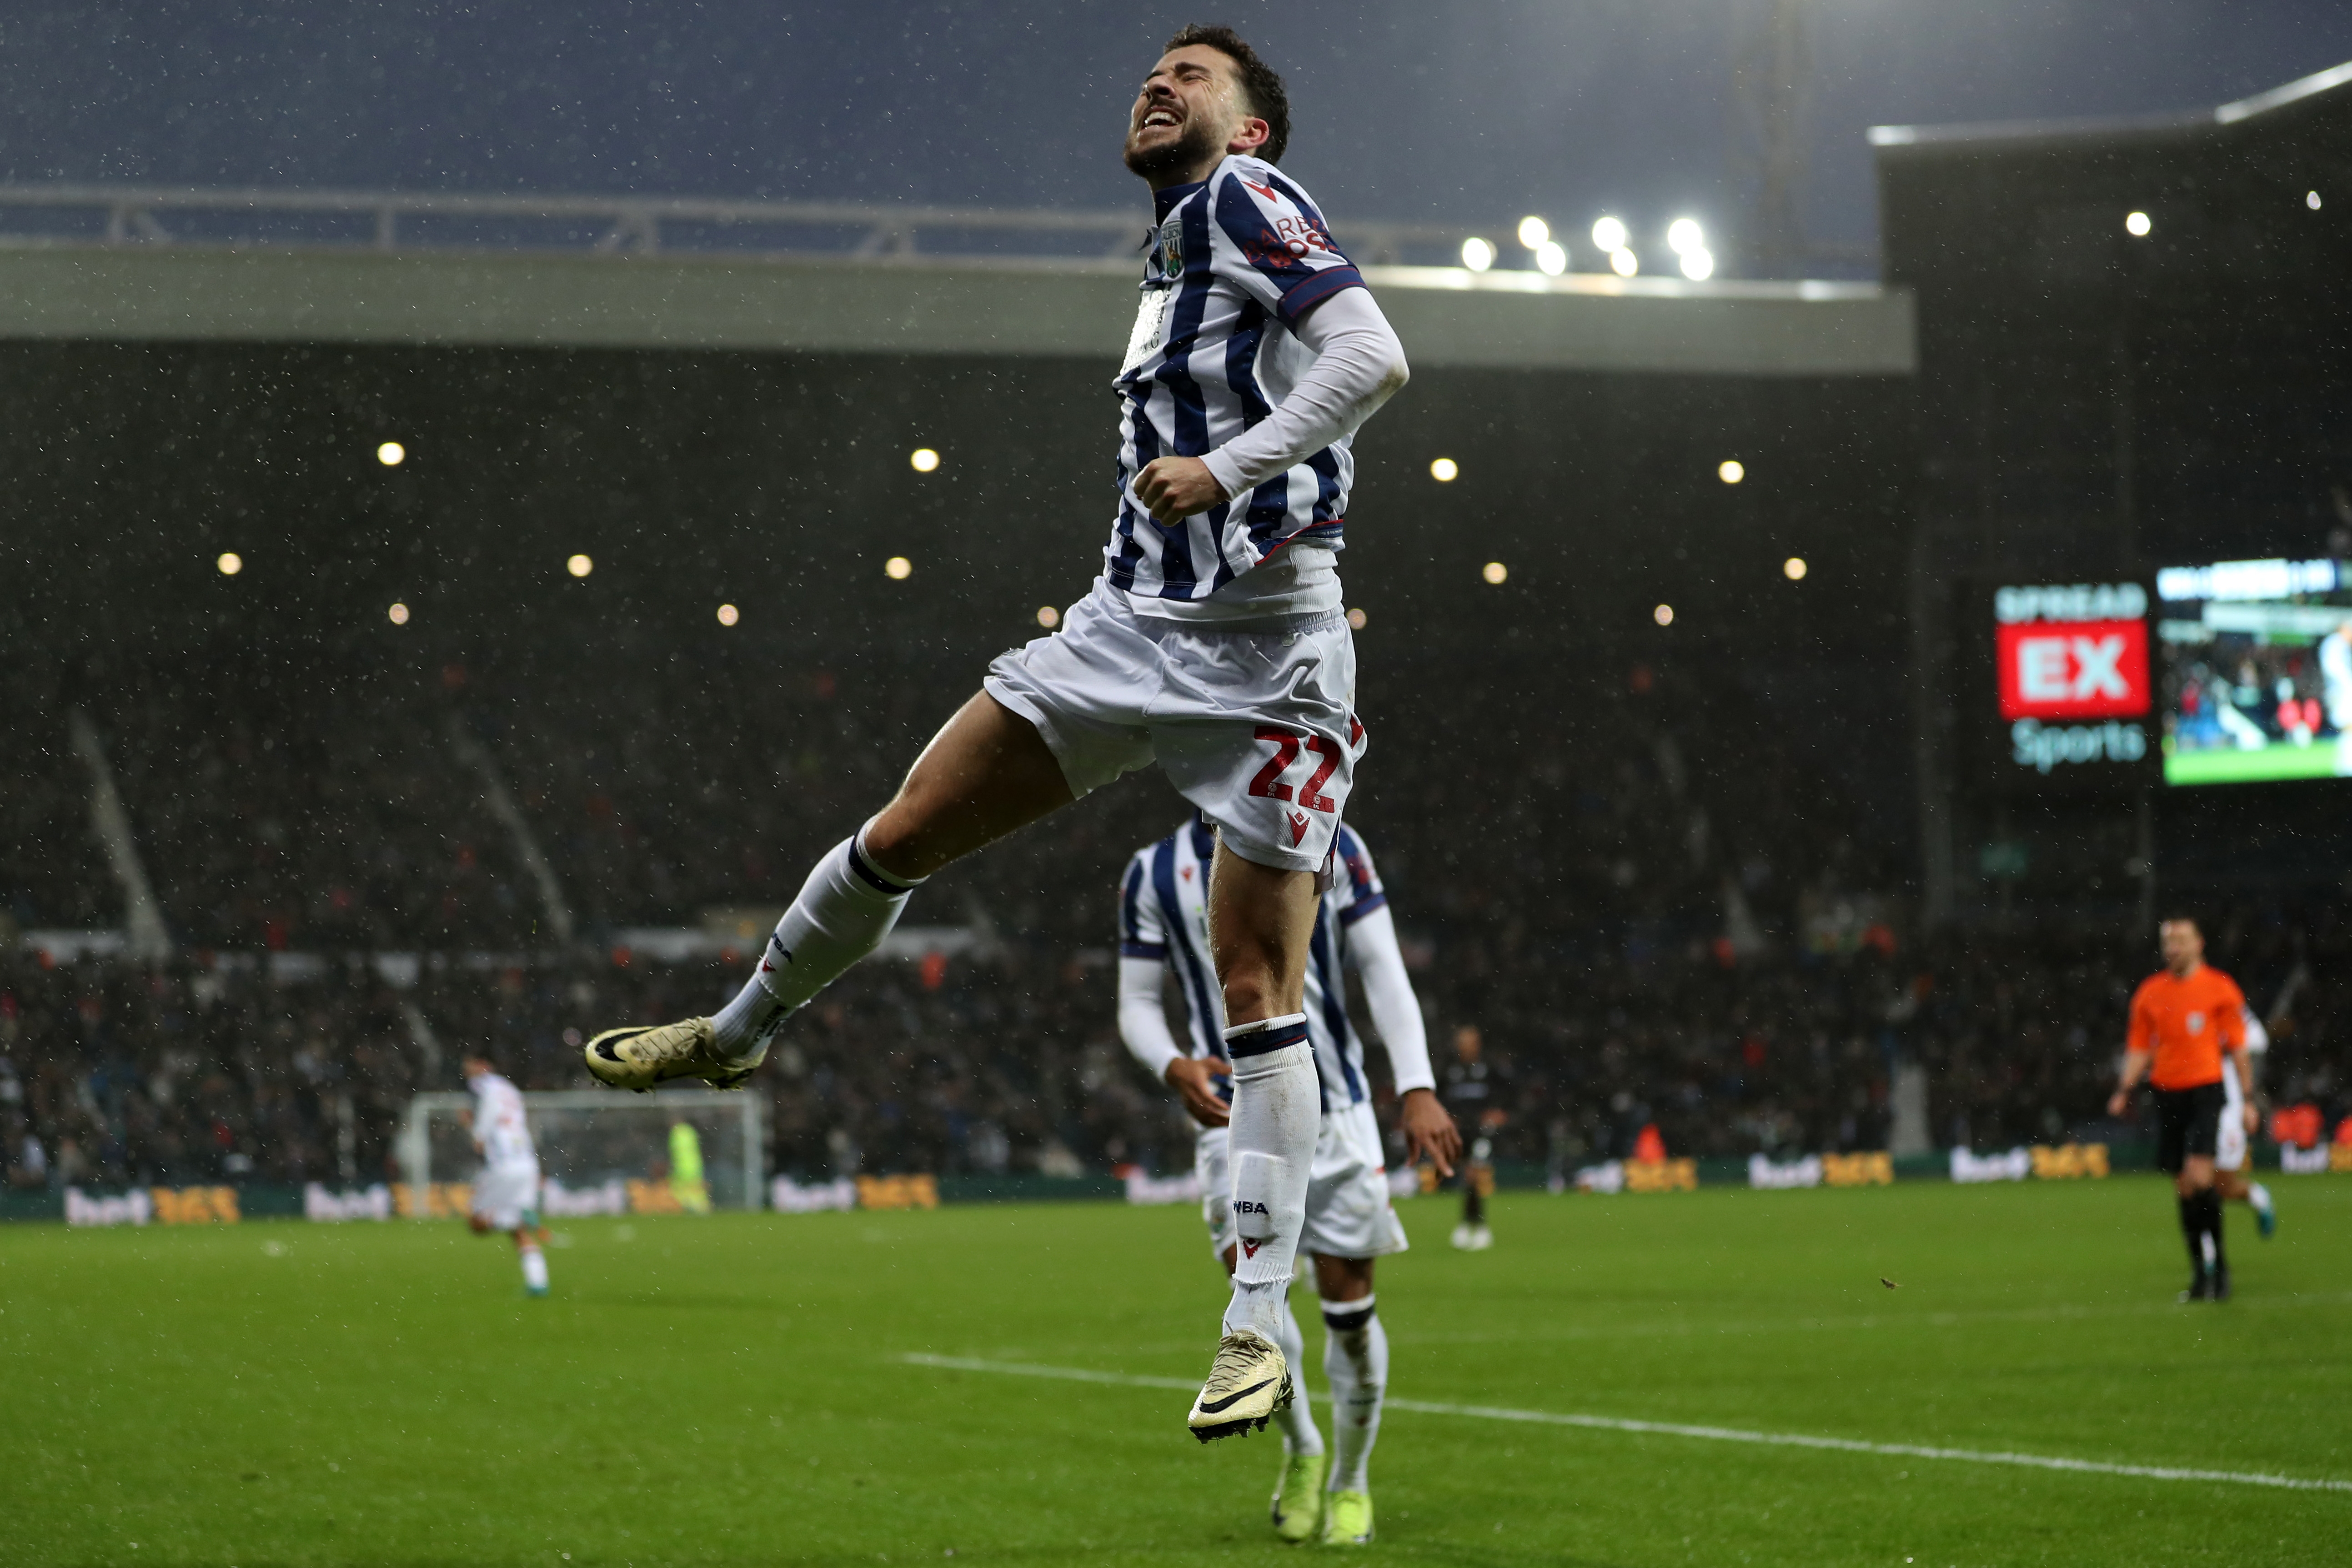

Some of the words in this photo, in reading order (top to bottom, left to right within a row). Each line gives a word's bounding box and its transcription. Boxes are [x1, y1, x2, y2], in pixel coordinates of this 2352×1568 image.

[1995, 584, 2147, 622] SPREAD
[2017, 634, 2129, 702] EX
[1249, 726, 1340, 813] 22
[2011, 717, 2146, 775] Sports
